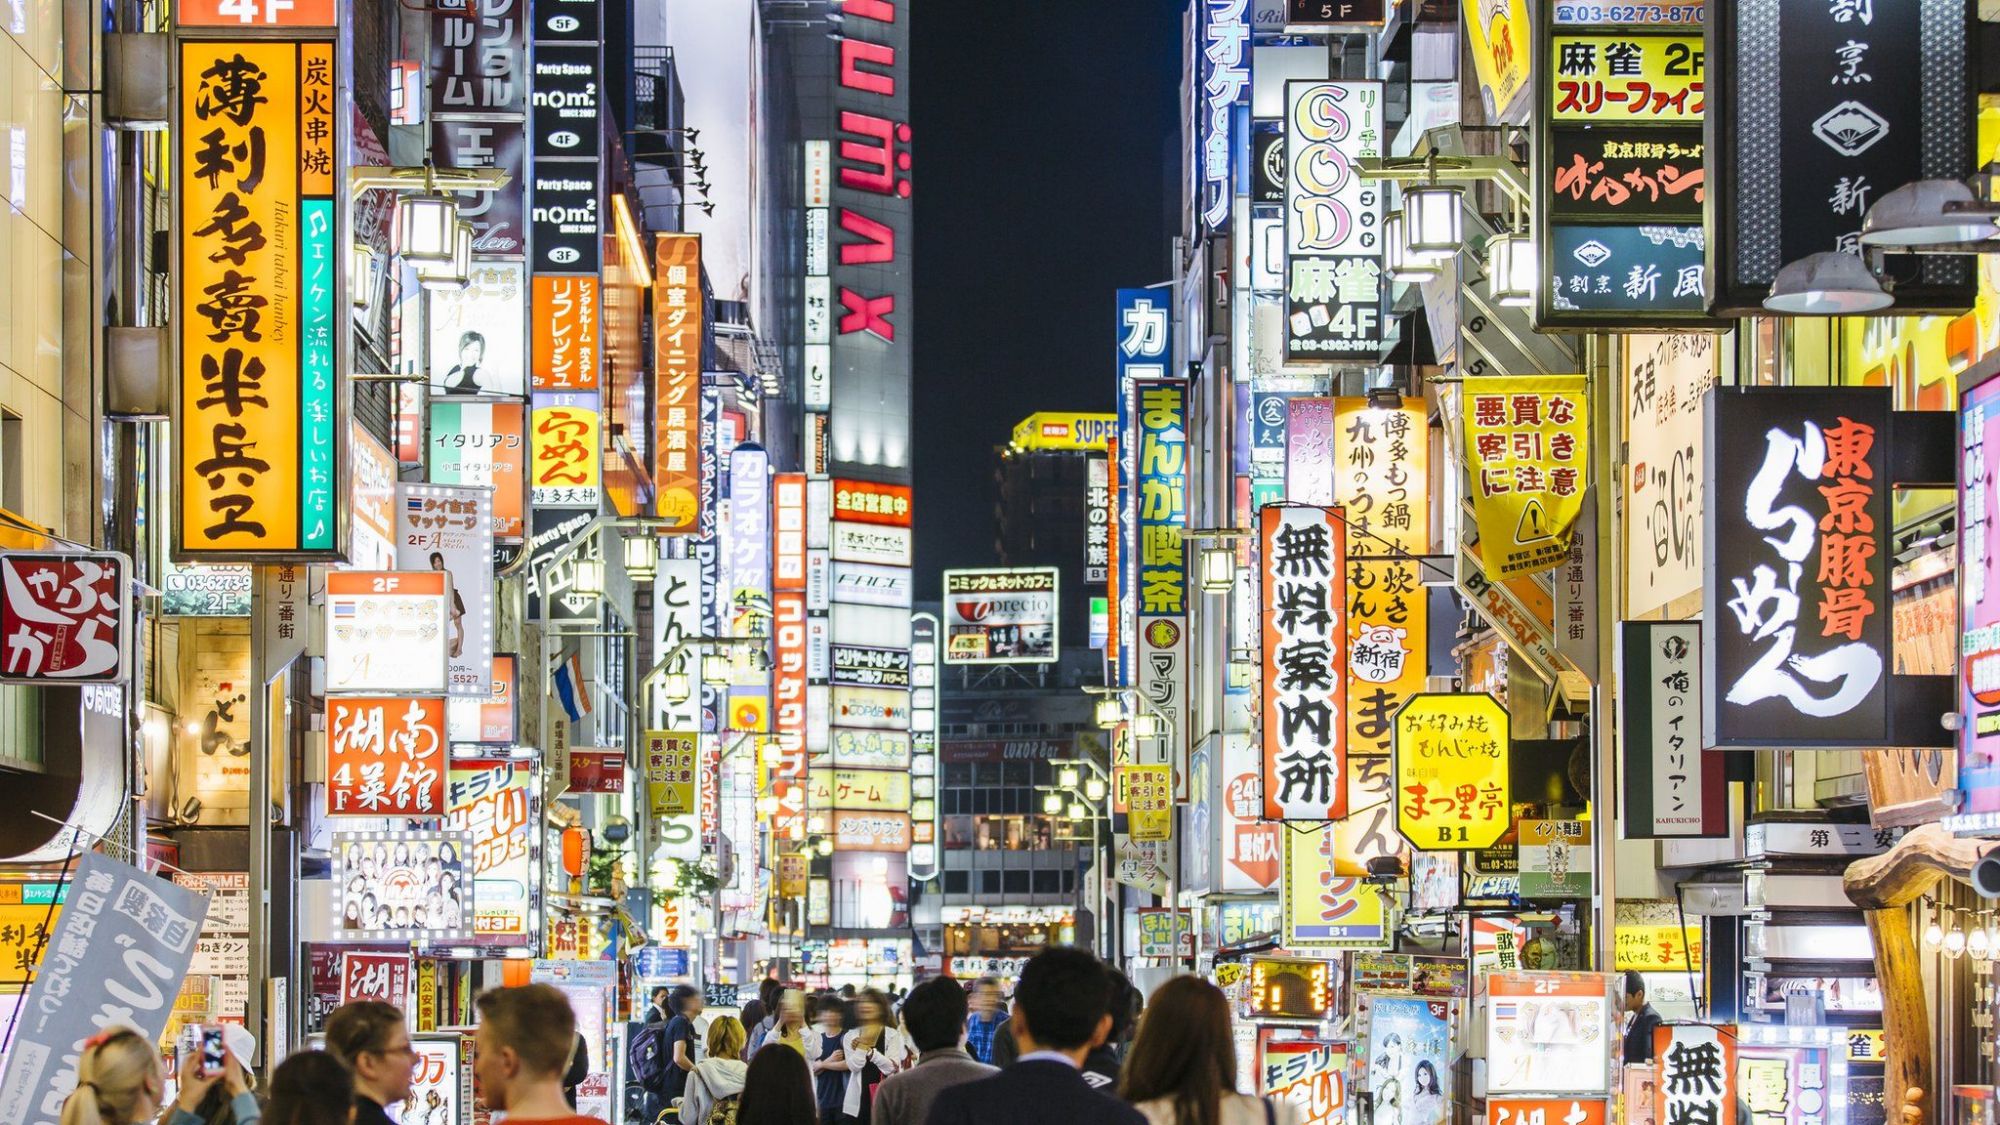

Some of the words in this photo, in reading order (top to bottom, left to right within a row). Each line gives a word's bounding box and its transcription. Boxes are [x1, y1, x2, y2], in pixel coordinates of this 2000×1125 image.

[556, 19, 572, 29] 5F
[1557, 42, 1642, 77] 麻雀
[536, 64, 561, 76] Party
[563, 64, 592, 76] Space
[302, 58, 332, 176] 炭火串焼
[556, 134, 572, 145] 4F
[536, 180, 561, 192] Party
[563, 180, 592, 192] Space
[273, 200, 289, 250] Hakuri
[1360, 191, 1375, 247] ゴッド
[556, 250, 572, 261] 3F
[273, 253, 289, 289] tabai
[1290, 257, 1380, 303] 麻雀
[1622, 263, 1704, 301] 新風
[578, 280, 592, 343] レンタルルーム
[1328, 305, 1376, 339] 4F
[1469, 315, 1487, 333] 6
[551, 279, 572, 387] リフレッシュ
[579, 348, 592, 383] ホステル
[666, 265, 687, 472] 個室ダイニング居酒屋
[532, 377, 545, 386] 2F
[552, 394, 576, 406] 1F
[1475, 395, 1576, 428] 悪質な
[435, 433, 521, 448] イタリアン
[538, 411, 590, 485] らーめん
[1477, 431, 1577, 462] 客引き
[441, 462, 513, 473] 小皿イタリアン
[1381, 411, 1411, 531] 博多もつ鍋
[1480, 465, 1579, 498] に注意
[423, 499, 478, 515] タイ古式
[735, 452, 764, 566] カラオケ
[1142, 388, 1183, 613] まんが喫茶
[407, 514, 478, 531] マッサージ
[1087, 487, 1108, 566] 北の家族
[1816, 416, 1877, 641] 東京豚骨
[408, 534, 427, 546] 2F
[1725, 419, 1883, 718] らーめん
[373, 578, 399, 592] 2F
[949, 575, 1053, 590] コミック&ネットカフェ
[206, 593, 236, 611] 2F
[1275, 522, 1334, 804] 無料案内所
[1354, 643, 1400, 669] 新宿
[1405, 714, 1489, 734] お好み焼
[650, 738, 692, 751] 悪質な
[1418, 738, 1501, 759] もんじゃ焼
[1661, 670, 1690, 812] 俺のイタリアン
[650, 754, 692, 767] 客引き
[604, 778, 622, 789] 2F
[651, 770, 692, 782] に注意
[1130, 772, 1166, 783] 悪質な
[1130, 786, 1165, 797] 客引き
[1402, 782, 1504, 821] まつ里亭
[1131, 799, 1166, 810] に注意
[1655, 817, 1701, 825] KABUKICHO
[1437, 826, 1470, 842] B1
[1329, 926, 1349, 937] B1
[1534, 980, 1561, 994] 2F
[1430, 1003, 1445, 1016] 3F
[1266, 1045, 1331, 1089] キラリ
